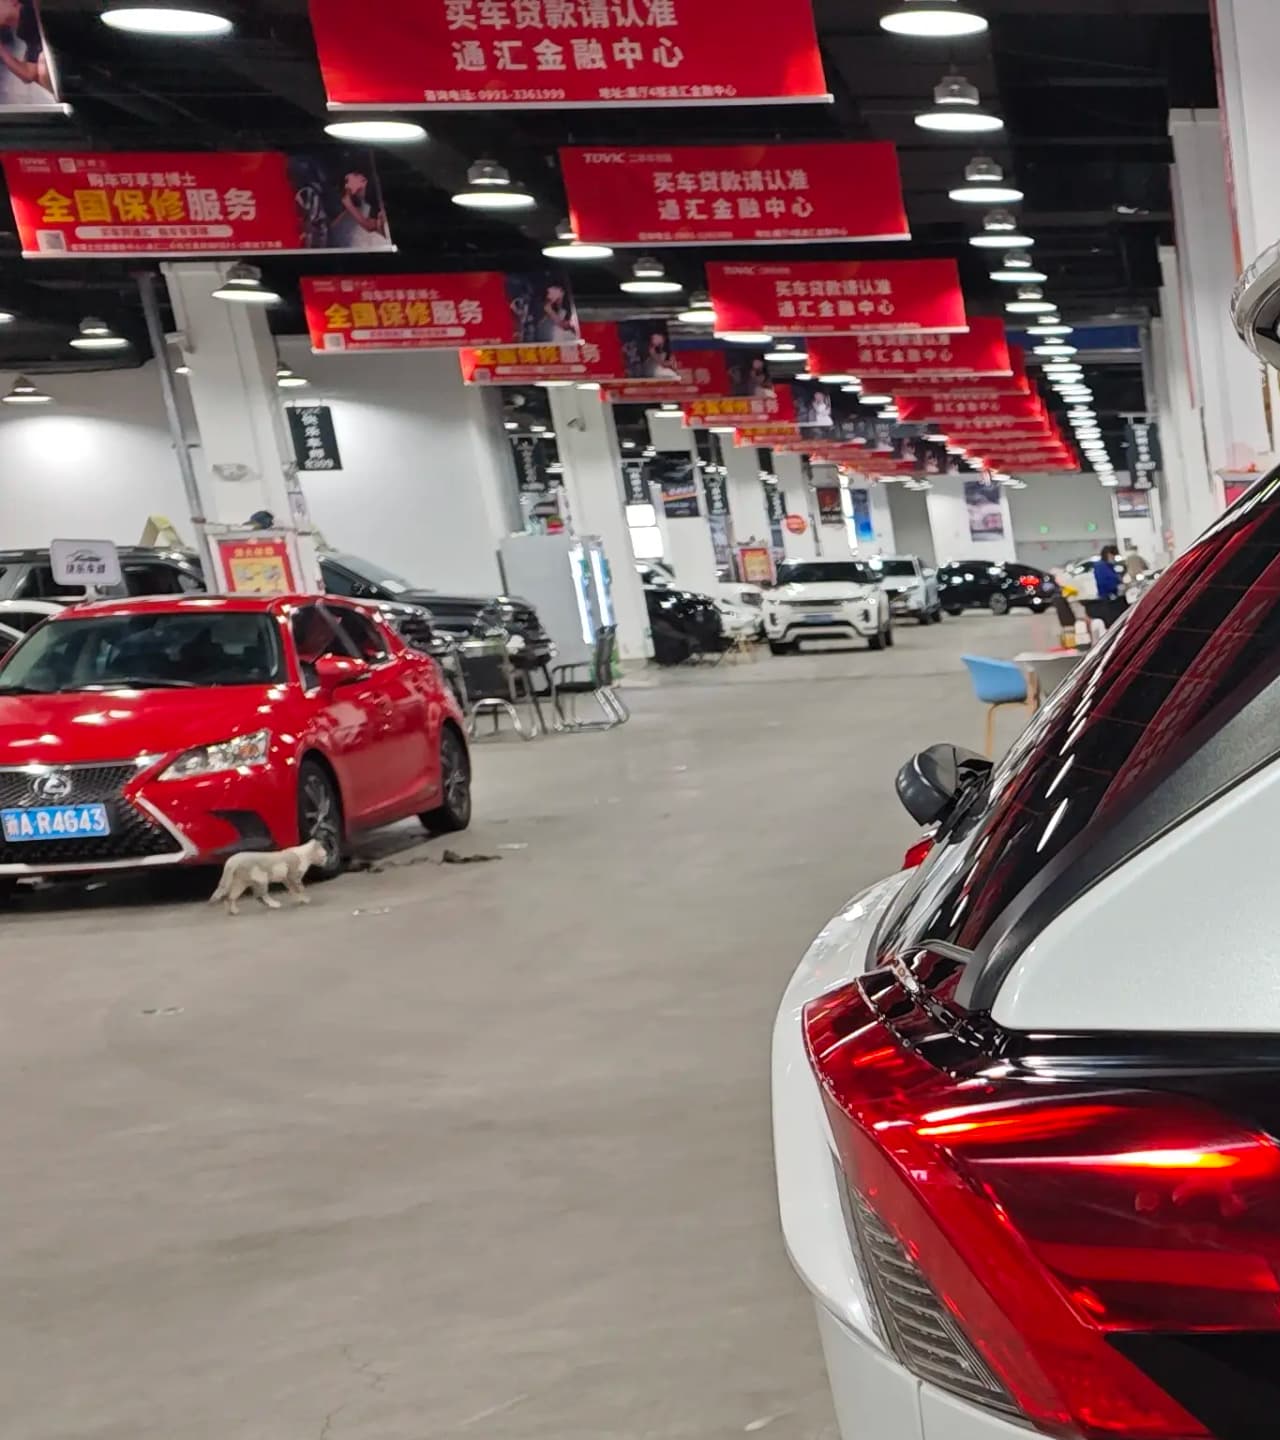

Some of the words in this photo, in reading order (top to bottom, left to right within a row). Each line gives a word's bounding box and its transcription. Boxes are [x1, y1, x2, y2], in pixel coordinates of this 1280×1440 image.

[445, 0, 679, 30] 买车贷款请认准
[452, 38, 684, 71] 通汇金融中心
[653, 169, 809, 193] 买车贷款请认准
[37, 188, 256, 223] 全国保修服务
[659, 198, 814, 220] 通汇金融中心
[775, 279, 893, 296] 买车贷款请认准
[324, 299, 483, 328] 全国保修服务
[778, 300, 895, 317] 通汇金融中心
